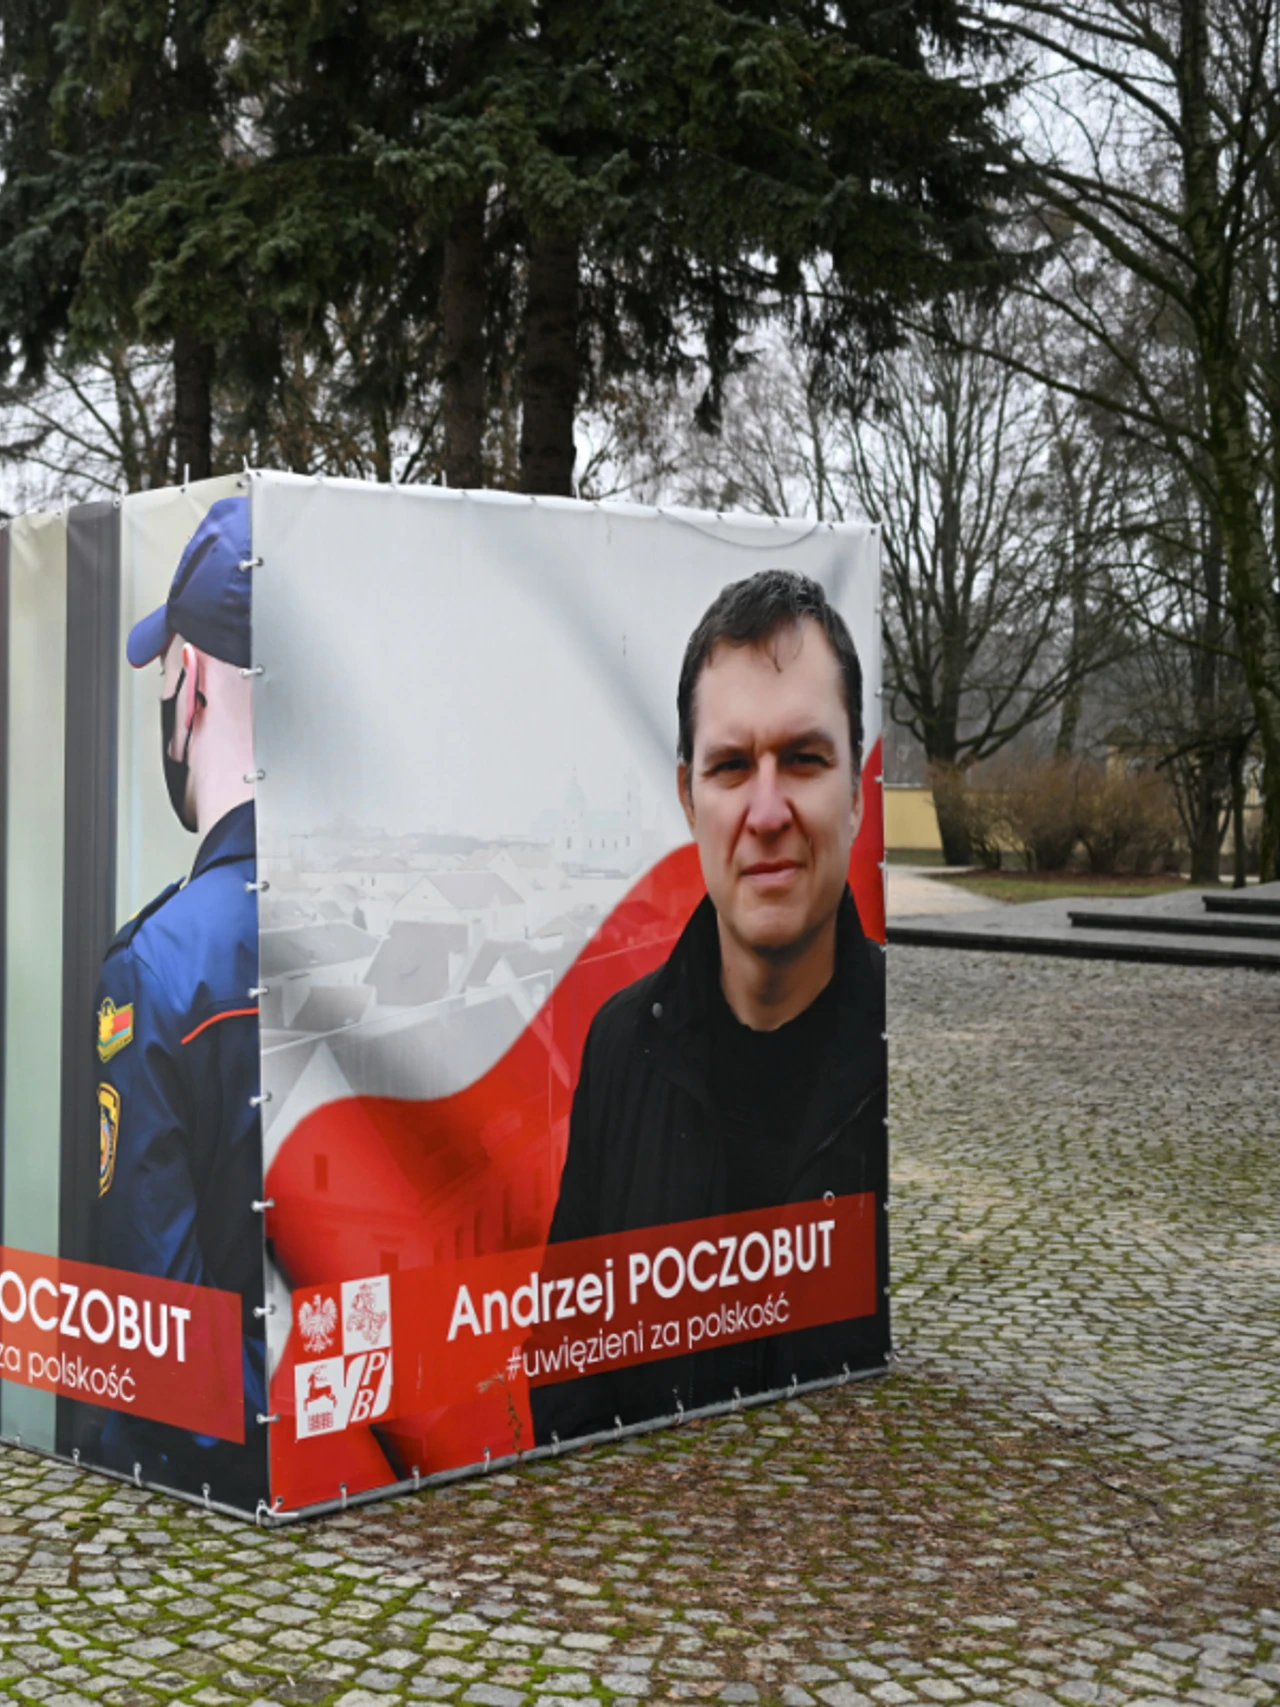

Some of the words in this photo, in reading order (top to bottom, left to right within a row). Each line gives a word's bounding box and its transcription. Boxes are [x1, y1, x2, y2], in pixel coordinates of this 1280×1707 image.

[447, 1258, 615, 1342] Andrzej
[628, 1220, 836, 1305] POCZOBUT
[28, 1351, 136, 1403] polskość
[505, 1325, 645, 1382] #uwięzieni
[650, 1315, 680, 1349] za
[688, 1291, 790, 1350] polskość
